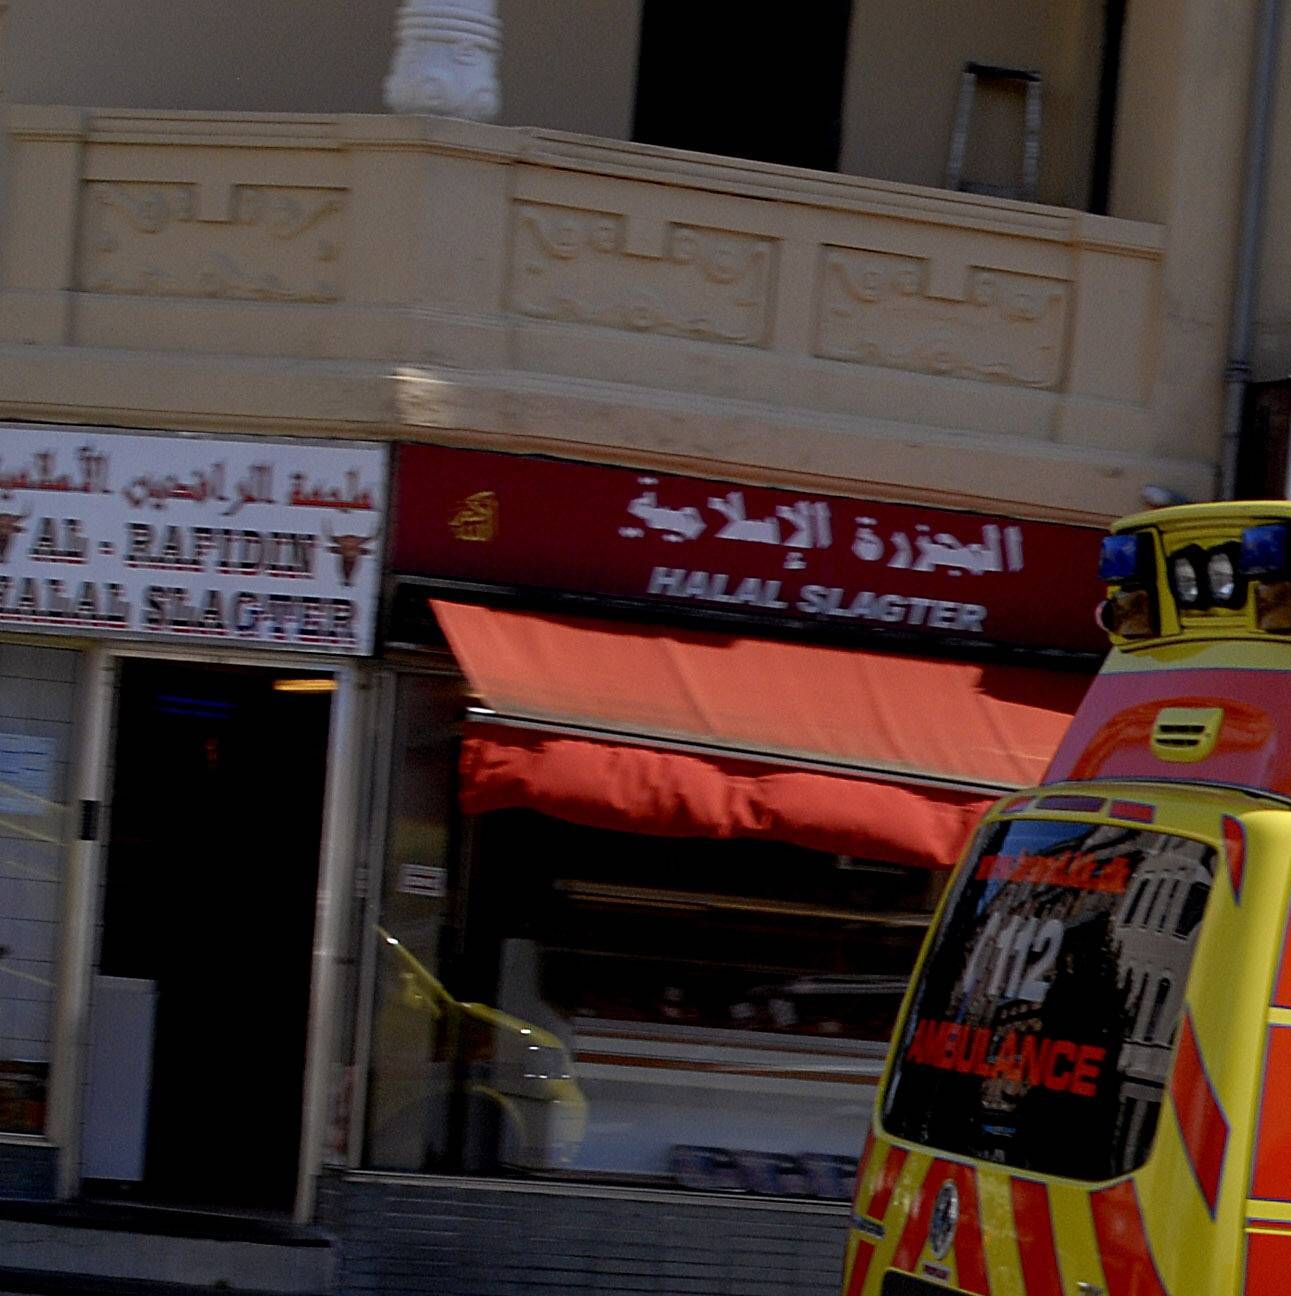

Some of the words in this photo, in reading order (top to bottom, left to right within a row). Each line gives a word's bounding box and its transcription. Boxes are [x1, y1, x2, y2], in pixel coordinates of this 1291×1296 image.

[144, 584, 357, 645] SLAGTER
[647, 566, 788, 609] HALAL
[800, 585, 987, 632] SLAGTER
[986, 914, 1064, 1003] 112
[906, 1017, 1106, 1098] AMBULANCE
